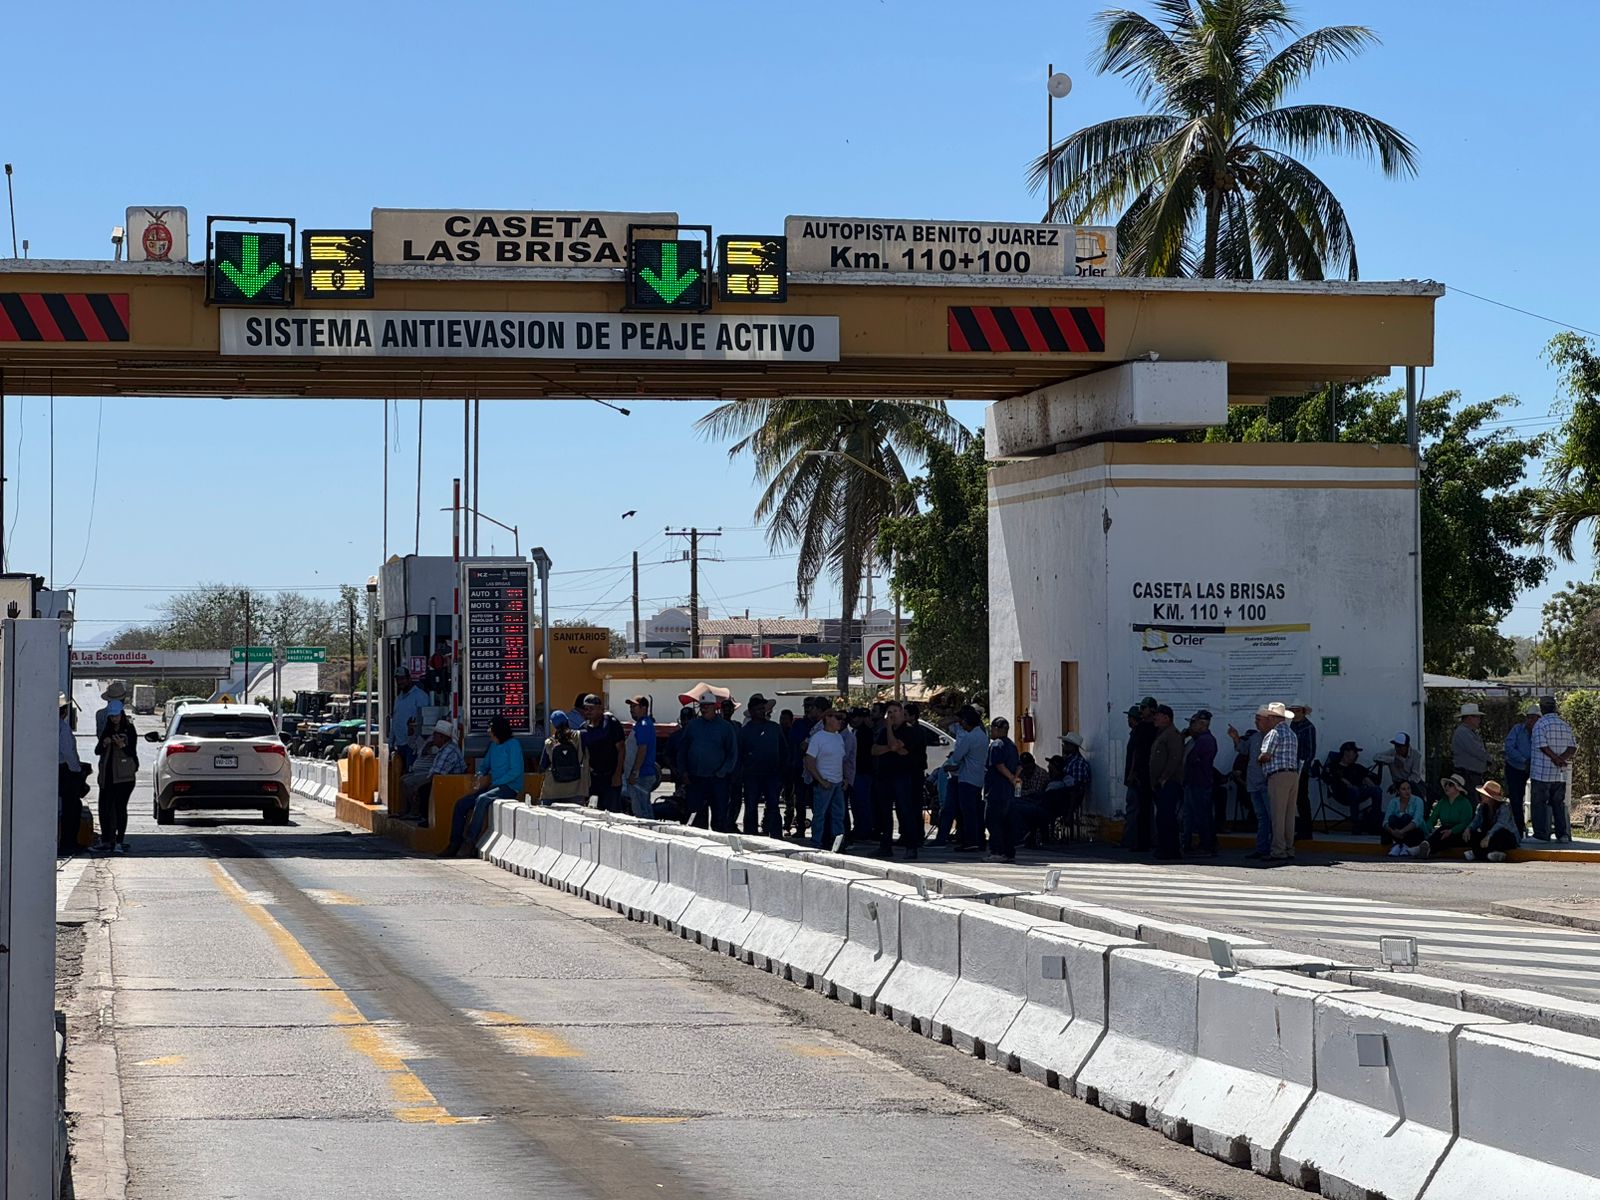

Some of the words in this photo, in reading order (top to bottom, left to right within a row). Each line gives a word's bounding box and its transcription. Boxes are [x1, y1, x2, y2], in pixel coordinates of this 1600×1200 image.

[445, 216, 607, 238] CASETA
[802, 222, 905, 242] AUTOPISTA
[912, 226, 982, 244] BENITO
[987, 228, 1059, 246] JUAREZ
[403, 240, 481, 262] LAS
[496, 240, 628, 263] BRISA
[830, 246, 889, 269] Km.
[901, 248, 1031, 273] 110+100
[246, 317, 372, 347] SISTEMA
[381, 319, 565, 350] ANTIEVASION
[576, 322, 610, 350] DE
[621, 322, 706, 351] PEAJE
[716, 323, 815, 352] ACTIVO
[1133, 582, 1192, 599] CASETA
[1197, 583, 1225, 599] LAS
[1230, 583, 1285, 600] BRISAS
[1153, 603, 1184, 620] KM.
[1191, 604, 1218, 620] 110
[1224, 606, 1232, 619] +
[1238, 604, 1266, 620] 100
[553, 632, 606, 641] SANITARIOS
[1172, 634, 1205, 645] Orler
[82, 652, 93, 660] La
[96, 651, 147, 660] Escondida
[568, 645, 588, 654] W.C.
[878, 647, 895, 672] E
